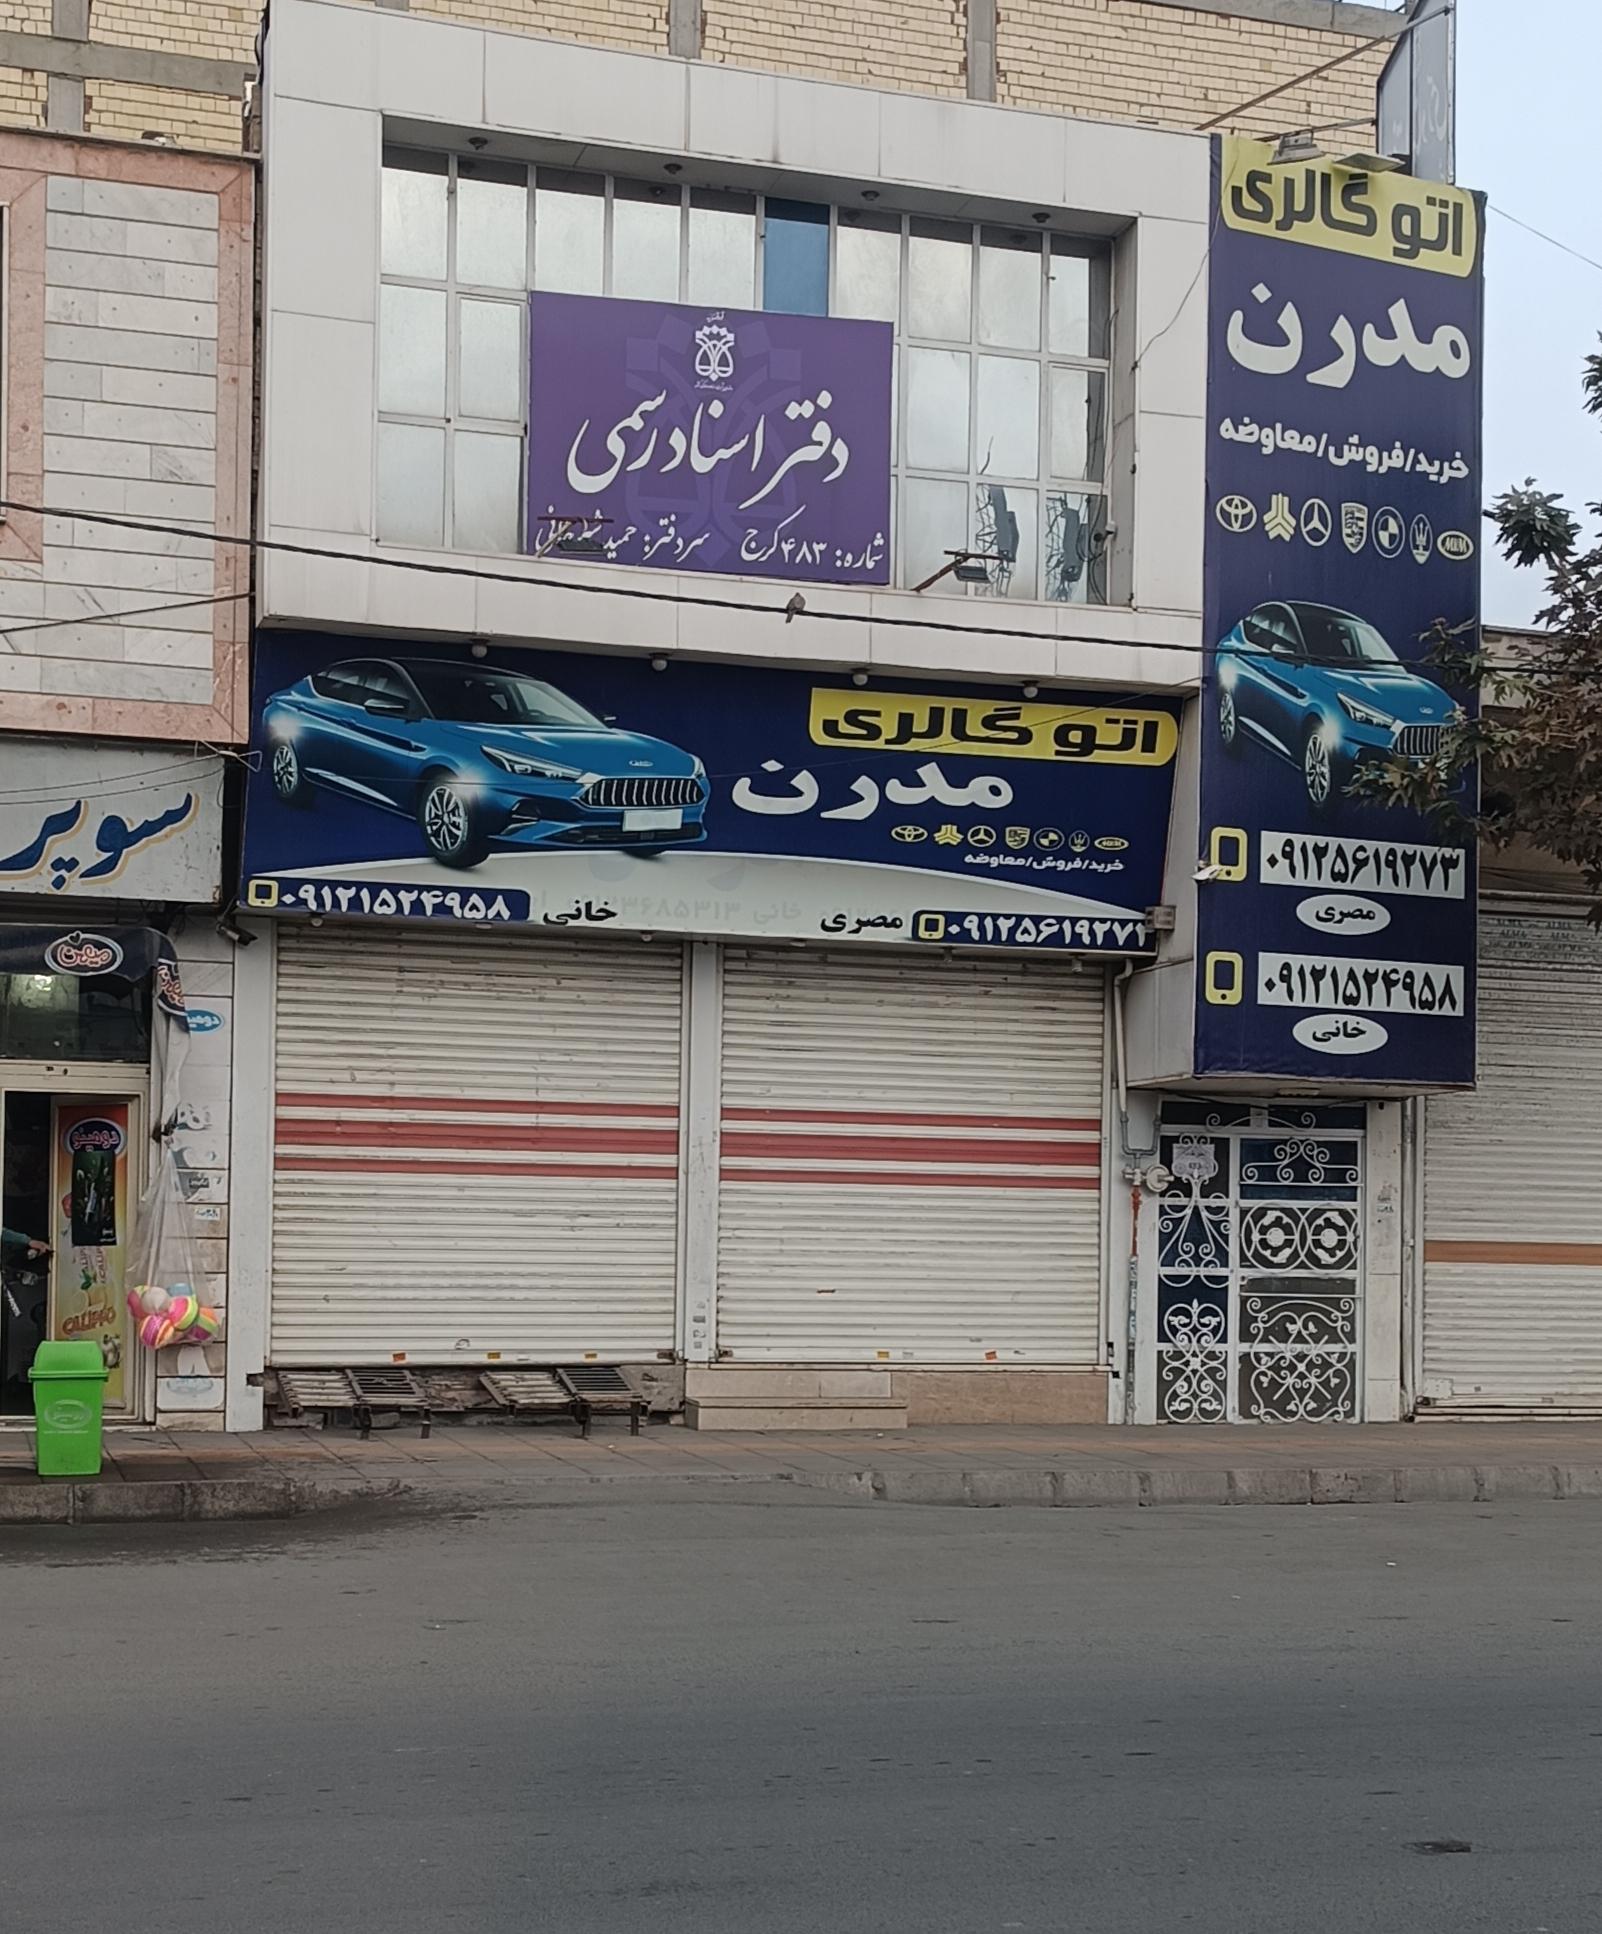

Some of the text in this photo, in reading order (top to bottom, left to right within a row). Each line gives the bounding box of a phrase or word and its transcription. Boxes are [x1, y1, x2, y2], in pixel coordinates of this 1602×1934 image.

[1230, 167, 1464, 261] اتو گالری
[1225, 281, 1472, 389] مدرن
[566, 388, 850, 511] دفتر اسناد رسمی
[740, 503, 807, 562] کرج
[780, 536, 828, 565] ۴۸۳
[821, 705, 1160, 758] اتو گالری
[731, 758, 1015, 821] مدرن
[0, 792, 193, 891] سوپر
[1265, 837, 1461, 892] ۰۹۱۲۵۶۱۹۲۷۳
[280, 883, 512, 922] ۰۹۱۲۱۵۲۴۹۵۸
[543, 899, 618, 925] خانی
[820, 913, 904, 934] مصری
[1314, 905, 1377, 925] مصری
[1263, 960, 1459, 1013] ۰۹۱۲۱۵۲۴۹۵۸
[1311, 1019, 1368, 1043] خانی
